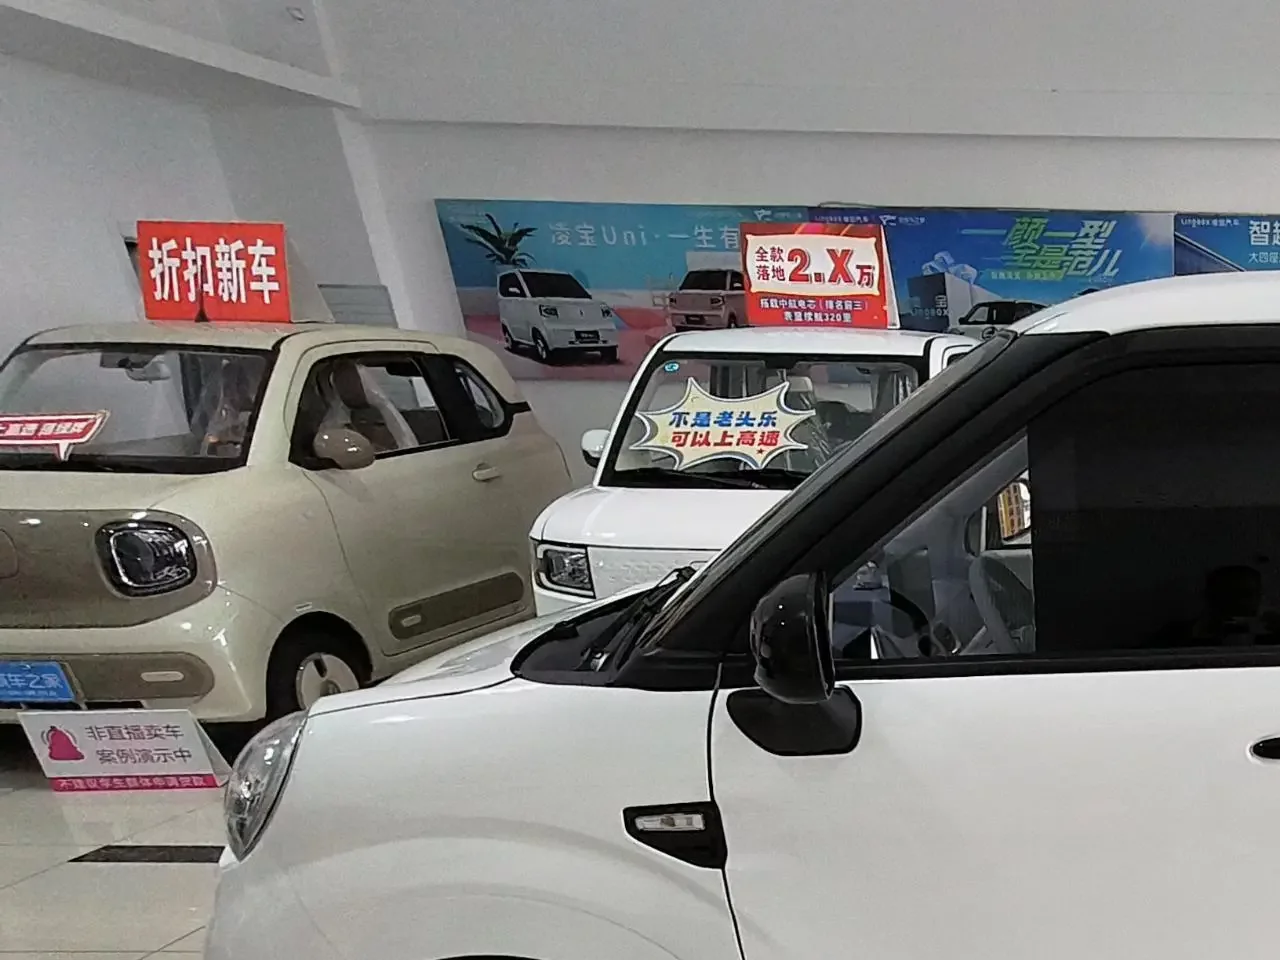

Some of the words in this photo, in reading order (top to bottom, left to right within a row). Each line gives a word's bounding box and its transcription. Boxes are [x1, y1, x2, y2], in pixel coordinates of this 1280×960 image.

[755, 246, 785, 263] 全款
[148, 237, 281, 305] 折扣新车
[755, 265, 786, 282] 落地
[669, 410, 779, 428] 不是老头乐
[671, 430, 781, 448] 可以上高速
[85, 723, 184, 741] 非直播卖车
[96, 747, 193, 765] 案例演示中
